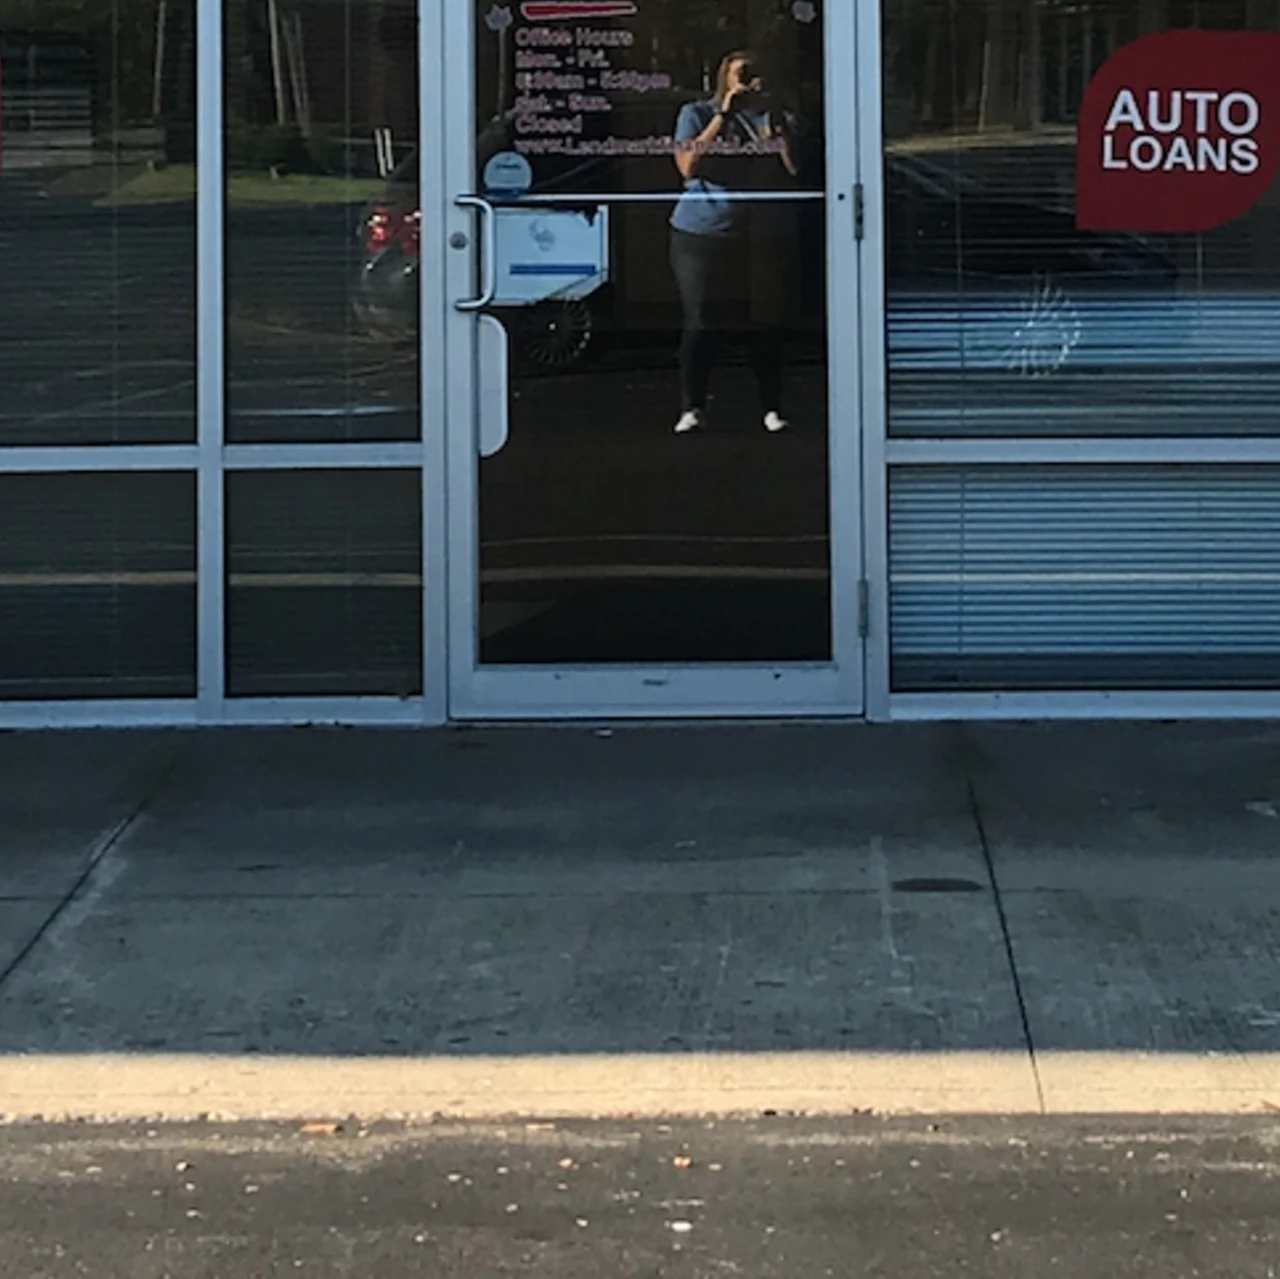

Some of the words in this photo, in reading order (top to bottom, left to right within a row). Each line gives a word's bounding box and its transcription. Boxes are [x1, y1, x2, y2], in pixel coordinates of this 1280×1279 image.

[515, 27, 572, 47] Office
[576, 26, 634, 47] Hours
[515, 114, 583, 134] Closed
[1104, 89, 1260, 135] AUTO
[1102, 135, 1260, 173] LOANS
